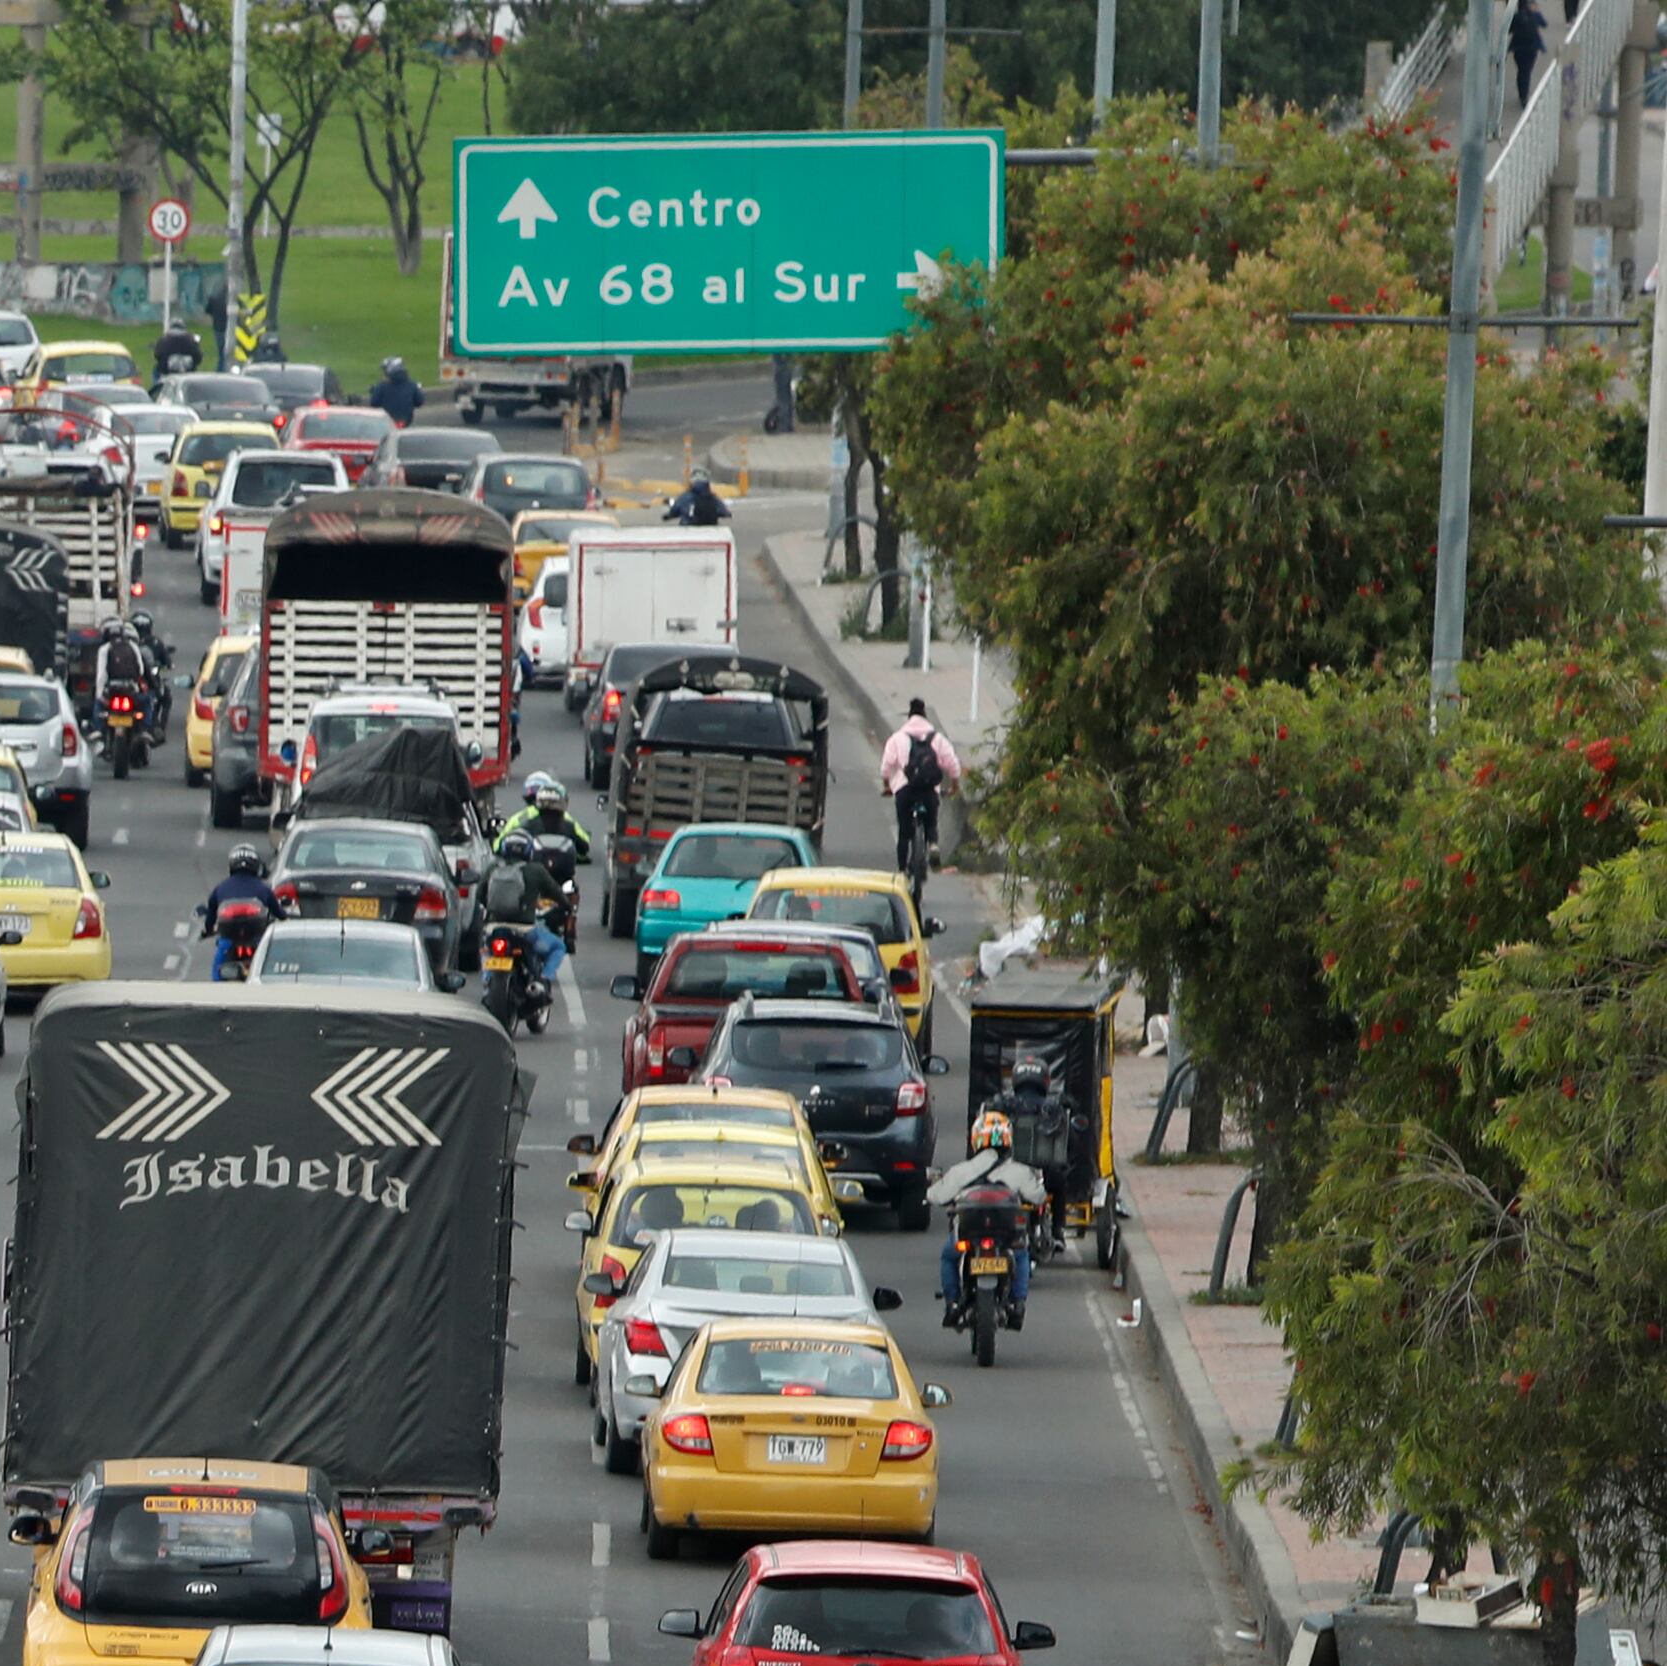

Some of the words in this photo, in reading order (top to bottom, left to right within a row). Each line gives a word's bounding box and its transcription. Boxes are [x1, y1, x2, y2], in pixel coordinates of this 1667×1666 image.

[157, 209, 182, 231] 30
[587, 186, 762, 229] Centro
[498, 265, 570, 308] Av
[599, 262, 675, 306] 68
[702, 266, 745, 304] al
[773, 258, 867, 303] Sur
[119, 1144, 410, 1214] Isabella
[190, 1582, 213, 1594] KIA
